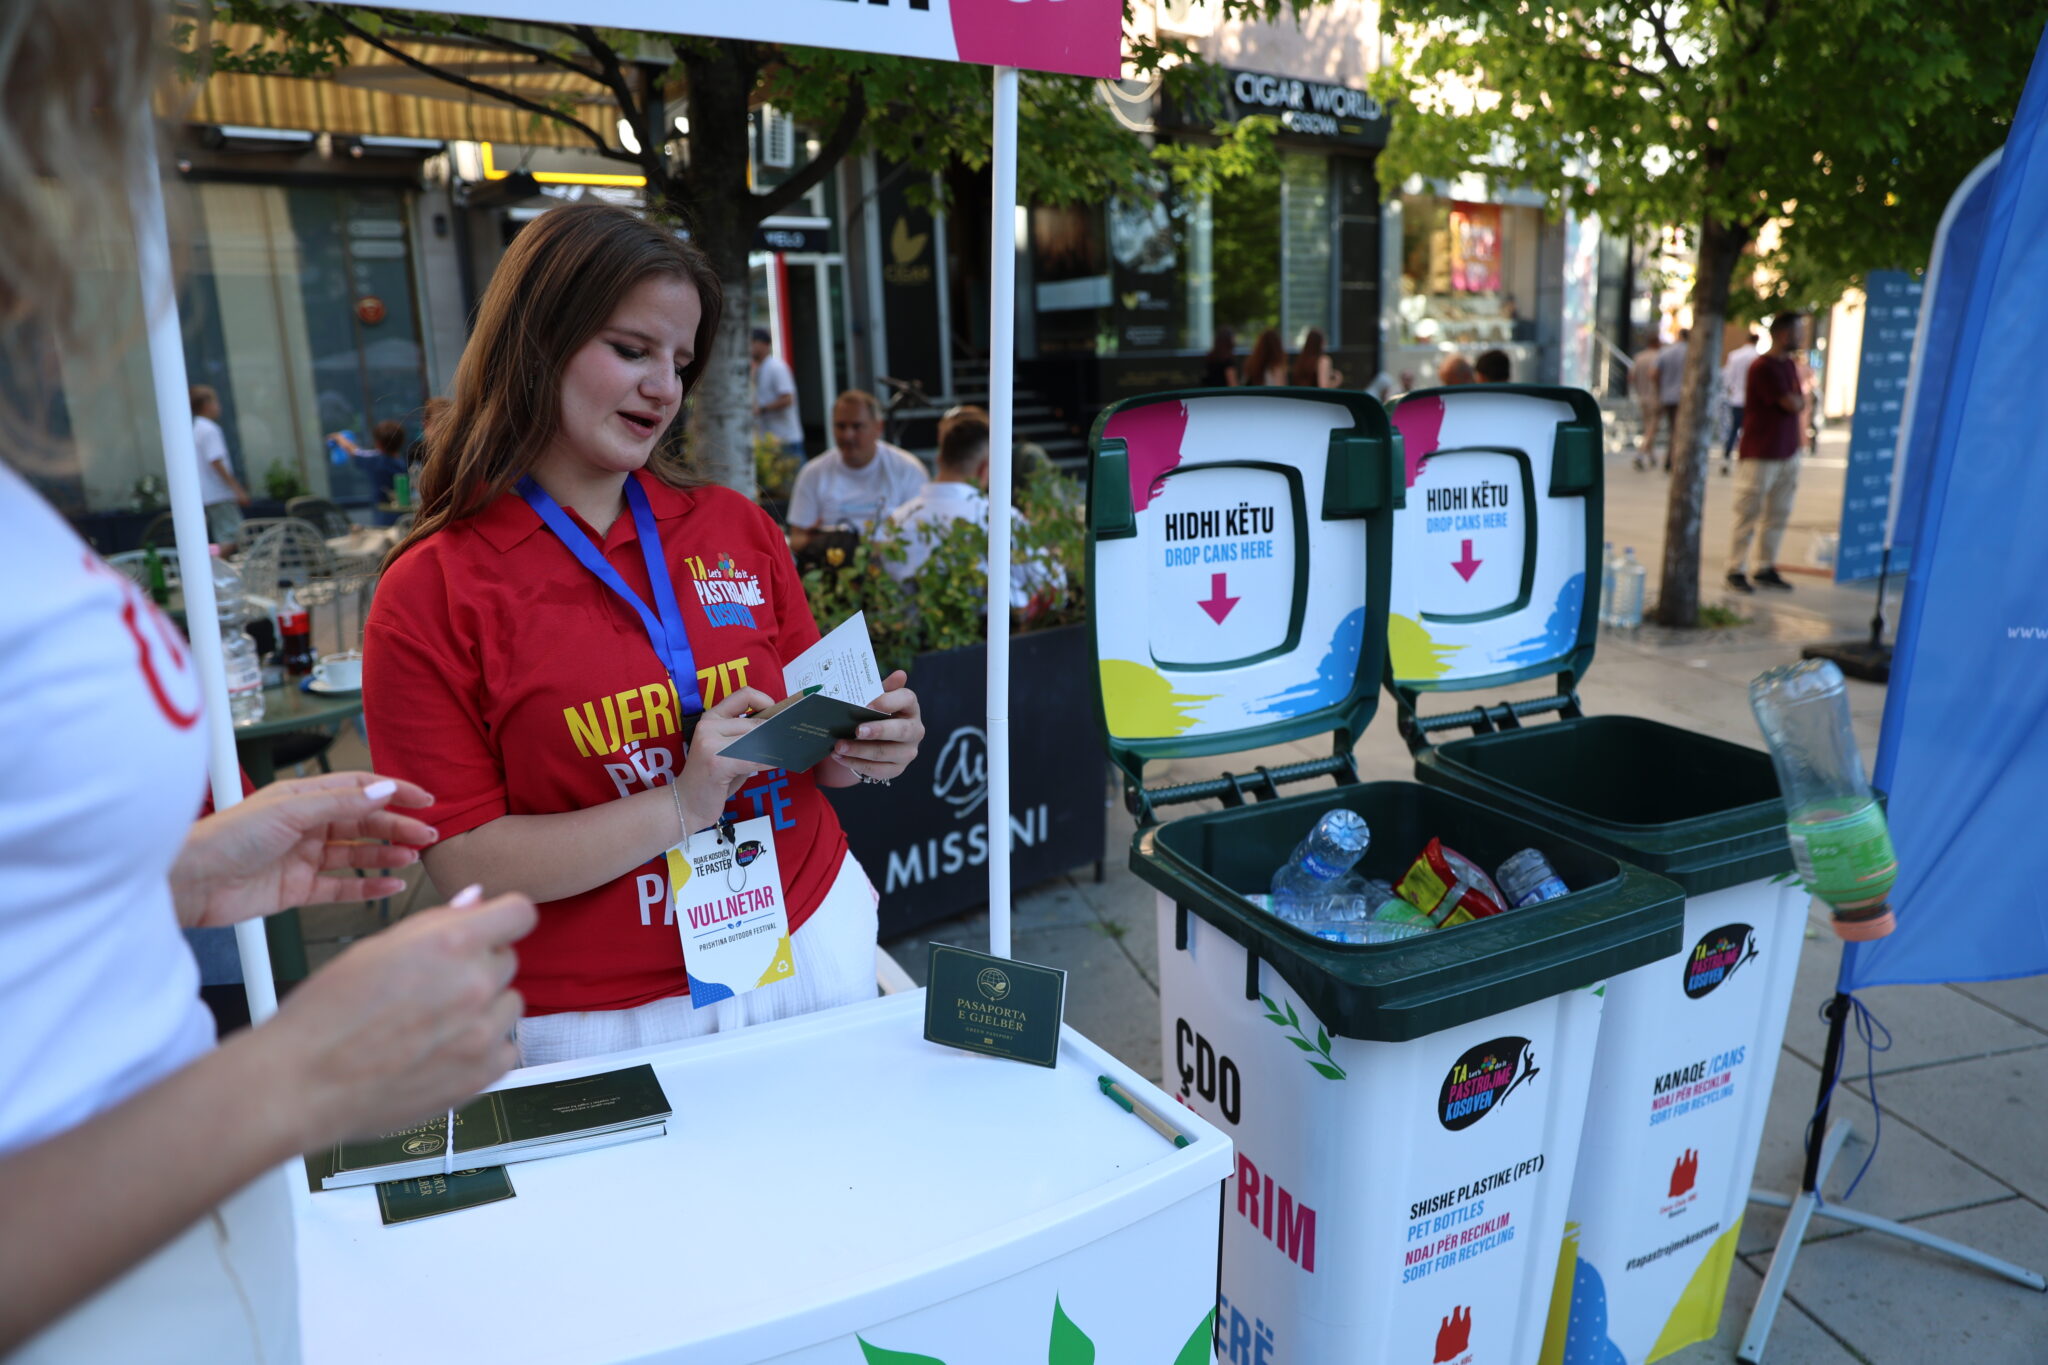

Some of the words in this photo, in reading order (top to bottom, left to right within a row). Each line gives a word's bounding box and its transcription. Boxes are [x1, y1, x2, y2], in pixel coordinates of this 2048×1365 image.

[1235, 72, 1305, 110] CIGAR
[1308, 83, 1382, 121] WORLD
[1426, 486, 1467, 512] HIDHI
[1471, 479, 1509, 509] KËTU
[1165, 509, 1220, 542] HIDHI
[1226, 501, 1275, 537] KËTU
[1426, 515, 1453, 534] DROP
[1455, 513, 1481, 531] CANS
[1482, 511, 1508, 529] HERE
[684, 555, 708, 580] TA
[1165, 545, 1201, 568] DROP
[1203, 542, 1238, 564] CANS
[1240, 539, 1274, 560] HERE
[693, 574, 766, 607] PASTROJMË
[885, 803, 1048, 895] MISSNI
[695, 863, 706, 878] TË
[705, 858, 733, 875] PASTËR
[687, 885, 775, 930] VULLNETAR
[699, 937, 728, 952] PRISHTINA
[728, 930, 753, 943] OUTDOOR
[753, 922, 777, 936] FESTIVAL
[1694, 943, 1707, 962] TA
[956, 997, 1027, 1021] PASAPORTA
[958, 1009, 967, 1020] E
[1175, 1017, 1242, 1126] ÇDO
[1453, 1063, 1468, 1085] TA
[1649, 1108, 1673, 1127] SORT
[1673, 1101, 1690, 1118] FOR
[1690, 1083, 1734, 1111] RECYCLING
[1651, 1093, 1676, 1112] NDAJ
[379, 1118, 465, 1140] PSAPORTA
[1409, 1189, 1456, 1220] SHISHE
[1457, 1167, 1513, 1204] PLASTIKE
[1513, 1153, 1545, 1183] (PET)
[1229, 1152, 1317, 1274] RIM
[1407, 1219, 1432, 1242] PET
[1433, 1199, 1485, 1235] BOTTLES
[1402, 1261, 1433, 1285] SORT
[1434, 1250, 1457, 1273] FOR
[1458, 1225, 1515, 1263] RECYCLING
[1405, 1246, 1435, 1267] NDAJ
[1437, 1233, 1458, 1254] PËR
[1460, 1212, 1511, 1245] RECIKLIM
